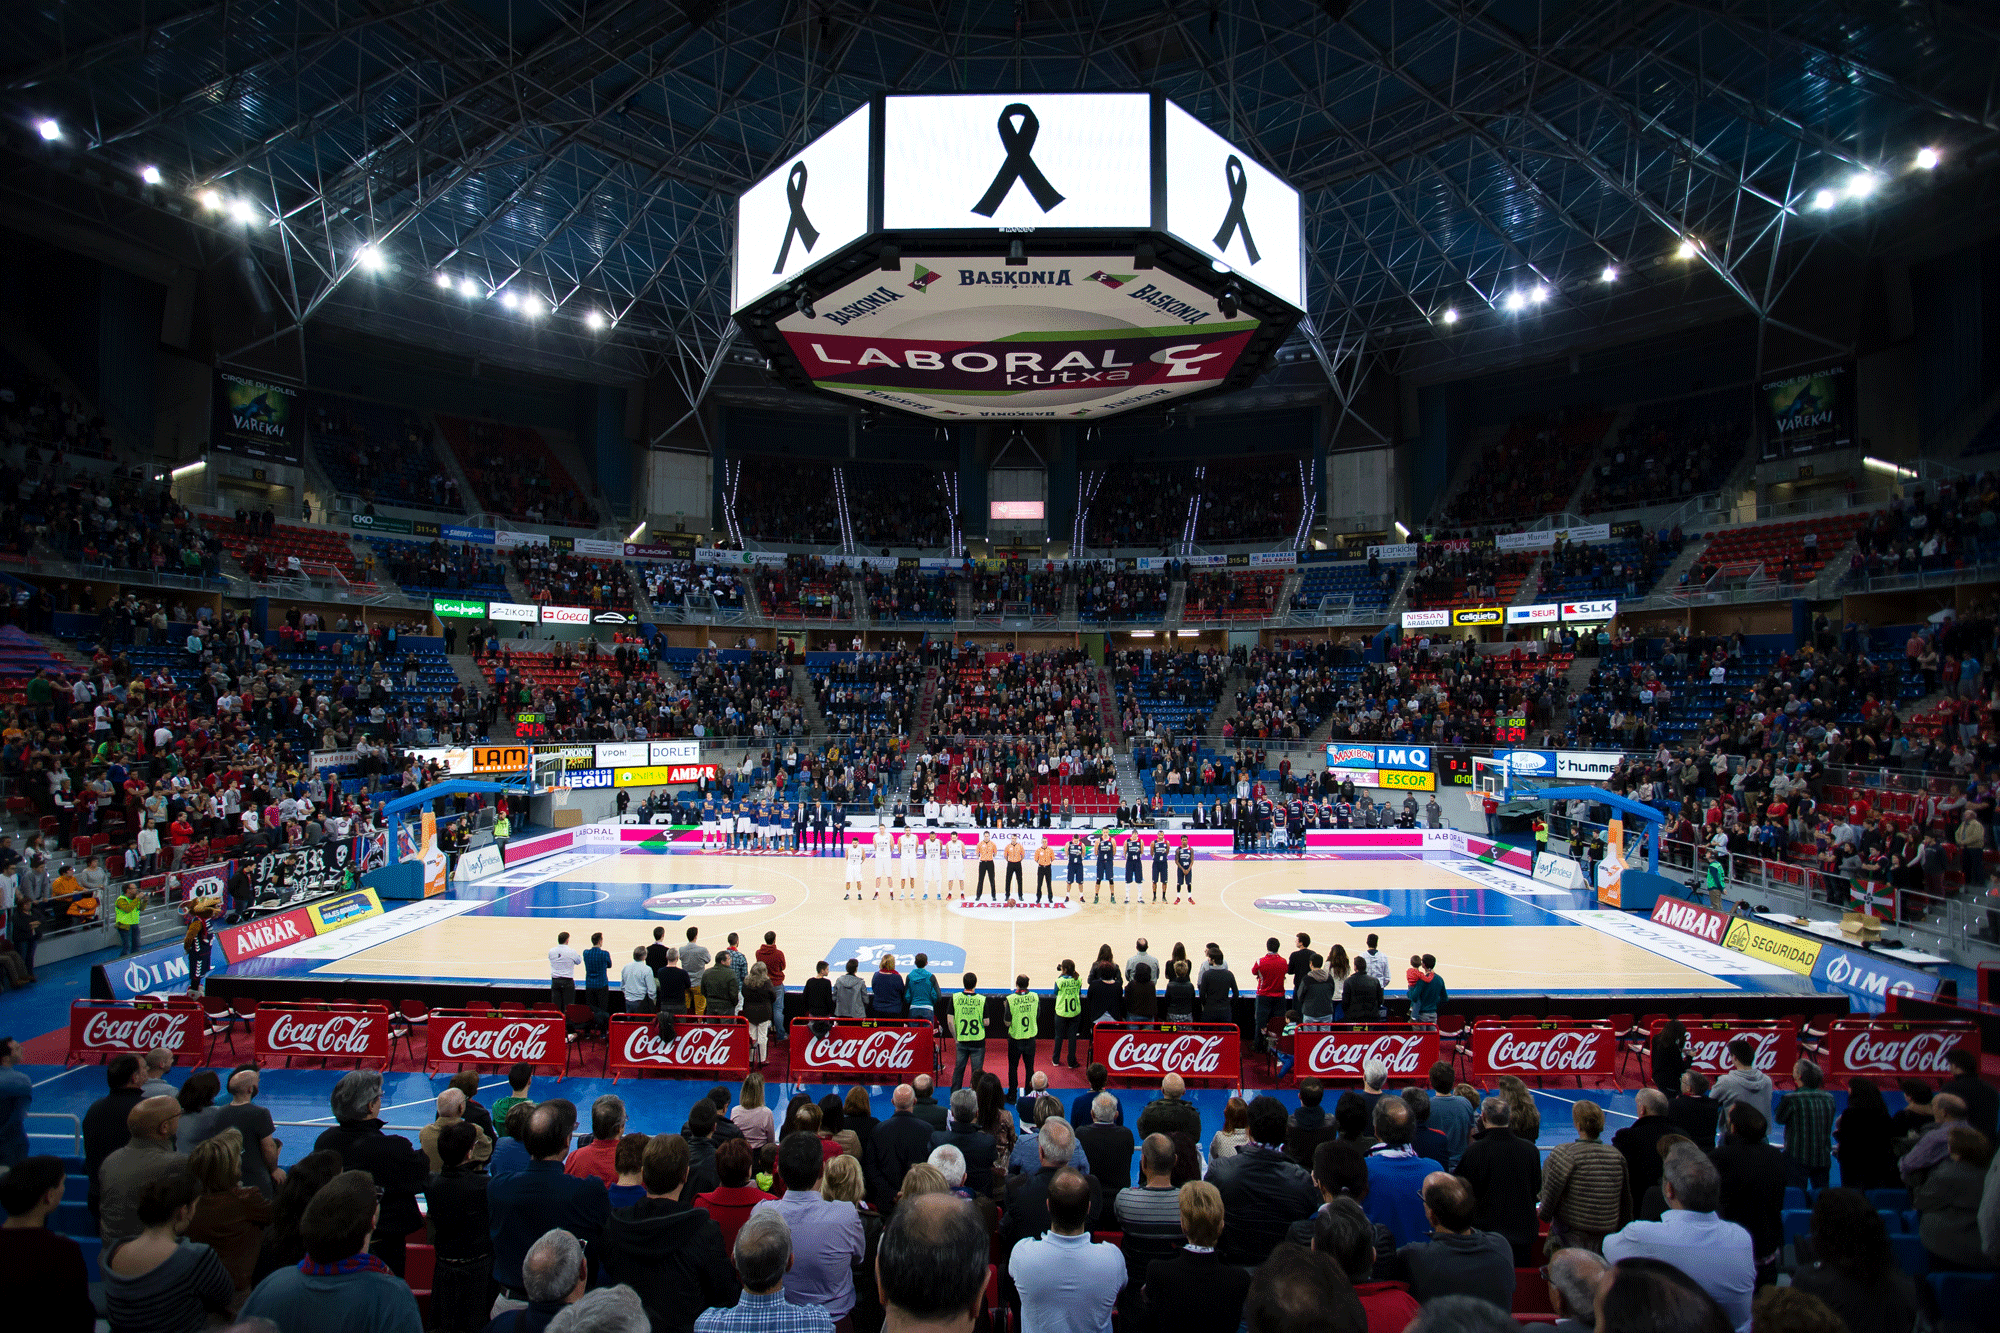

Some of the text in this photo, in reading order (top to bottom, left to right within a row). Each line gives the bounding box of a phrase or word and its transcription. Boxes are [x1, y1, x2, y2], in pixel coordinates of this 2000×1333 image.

[957, 269, 1073, 286] BASKONIA
[822, 286, 905, 326] BASKONIA
[1127, 283, 1211, 325] BASKONIA
[811, 343, 1133, 373] LABORAL
[221, 373, 299, 397] CIRQUE DU SOLEIL
[1006, 370, 1130, 386] kutxa
[232, 412, 285, 437] VAREKAI
[1776, 410, 1833, 433] VAREKAI
[416, 525, 438, 535] 311-A
[1498, 532, 1549, 544] Bodegas Muriel
[677, 550, 690, 558] 312
[504, 608, 534, 618] ZIKOTZ
[556, 610, 588, 622] Coeca
[1406, 612, 1444, 621] NISSAN
[1531, 609, 1555, 618] SEUR
[1579, 603, 1612, 614] SLK
[516, 722, 533, 737] 24
[1507, 727, 1525, 742] 24
[475, 750, 525, 767] LAM
[652, 746, 698, 757] DORLET
[1333, 748, 1375, 765] MAXIBON
[1378, 749, 1428, 769] IMQ
[670, 767, 717, 781] AMBAR
[1568, 759, 1615, 774] humme
[1387, 773, 1427, 786] ESCOR
[575, 828, 613, 838] LABORAL
[1428, 833, 1464, 844] LABORAL
[195, 881, 218, 896] OLD
[241, 917, 284, 933] CERVEZAS
[1654, 901, 1722, 941] AMBAR
[237, 919, 300, 955] AMBAR
[1751, 936, 1815, 967] SEGURIDAD
[153, 956, 190, 985] IM
[961, 1007, 976, 1015] COURT
[1018, 1005, 1032, 1013] COURT
[1064, 998, 1077, 1013] 10
[84, 1012, 188, 1053] Coca-Cola
[268, 1014, 373, 1052] Coca-Cola
[960, 1019, 979, 1036] 28
[1021, 1016, 1030, 1033] 9
[442, 1021, 550, 1059] Coca-Cola
[624, 1026, 734, 1064] Coca-Cola
[804, 1031, 917, 1068] Coca-Cola
[1108, 1034, 1223, 1072] Coca-Cola
[1309, 1035, 1423, 1073] Coca-Cola
[1488, 1033, 1600, 1070] Coca-Cola
[1844, 1033, 1952, 1070] Coca-Cola
